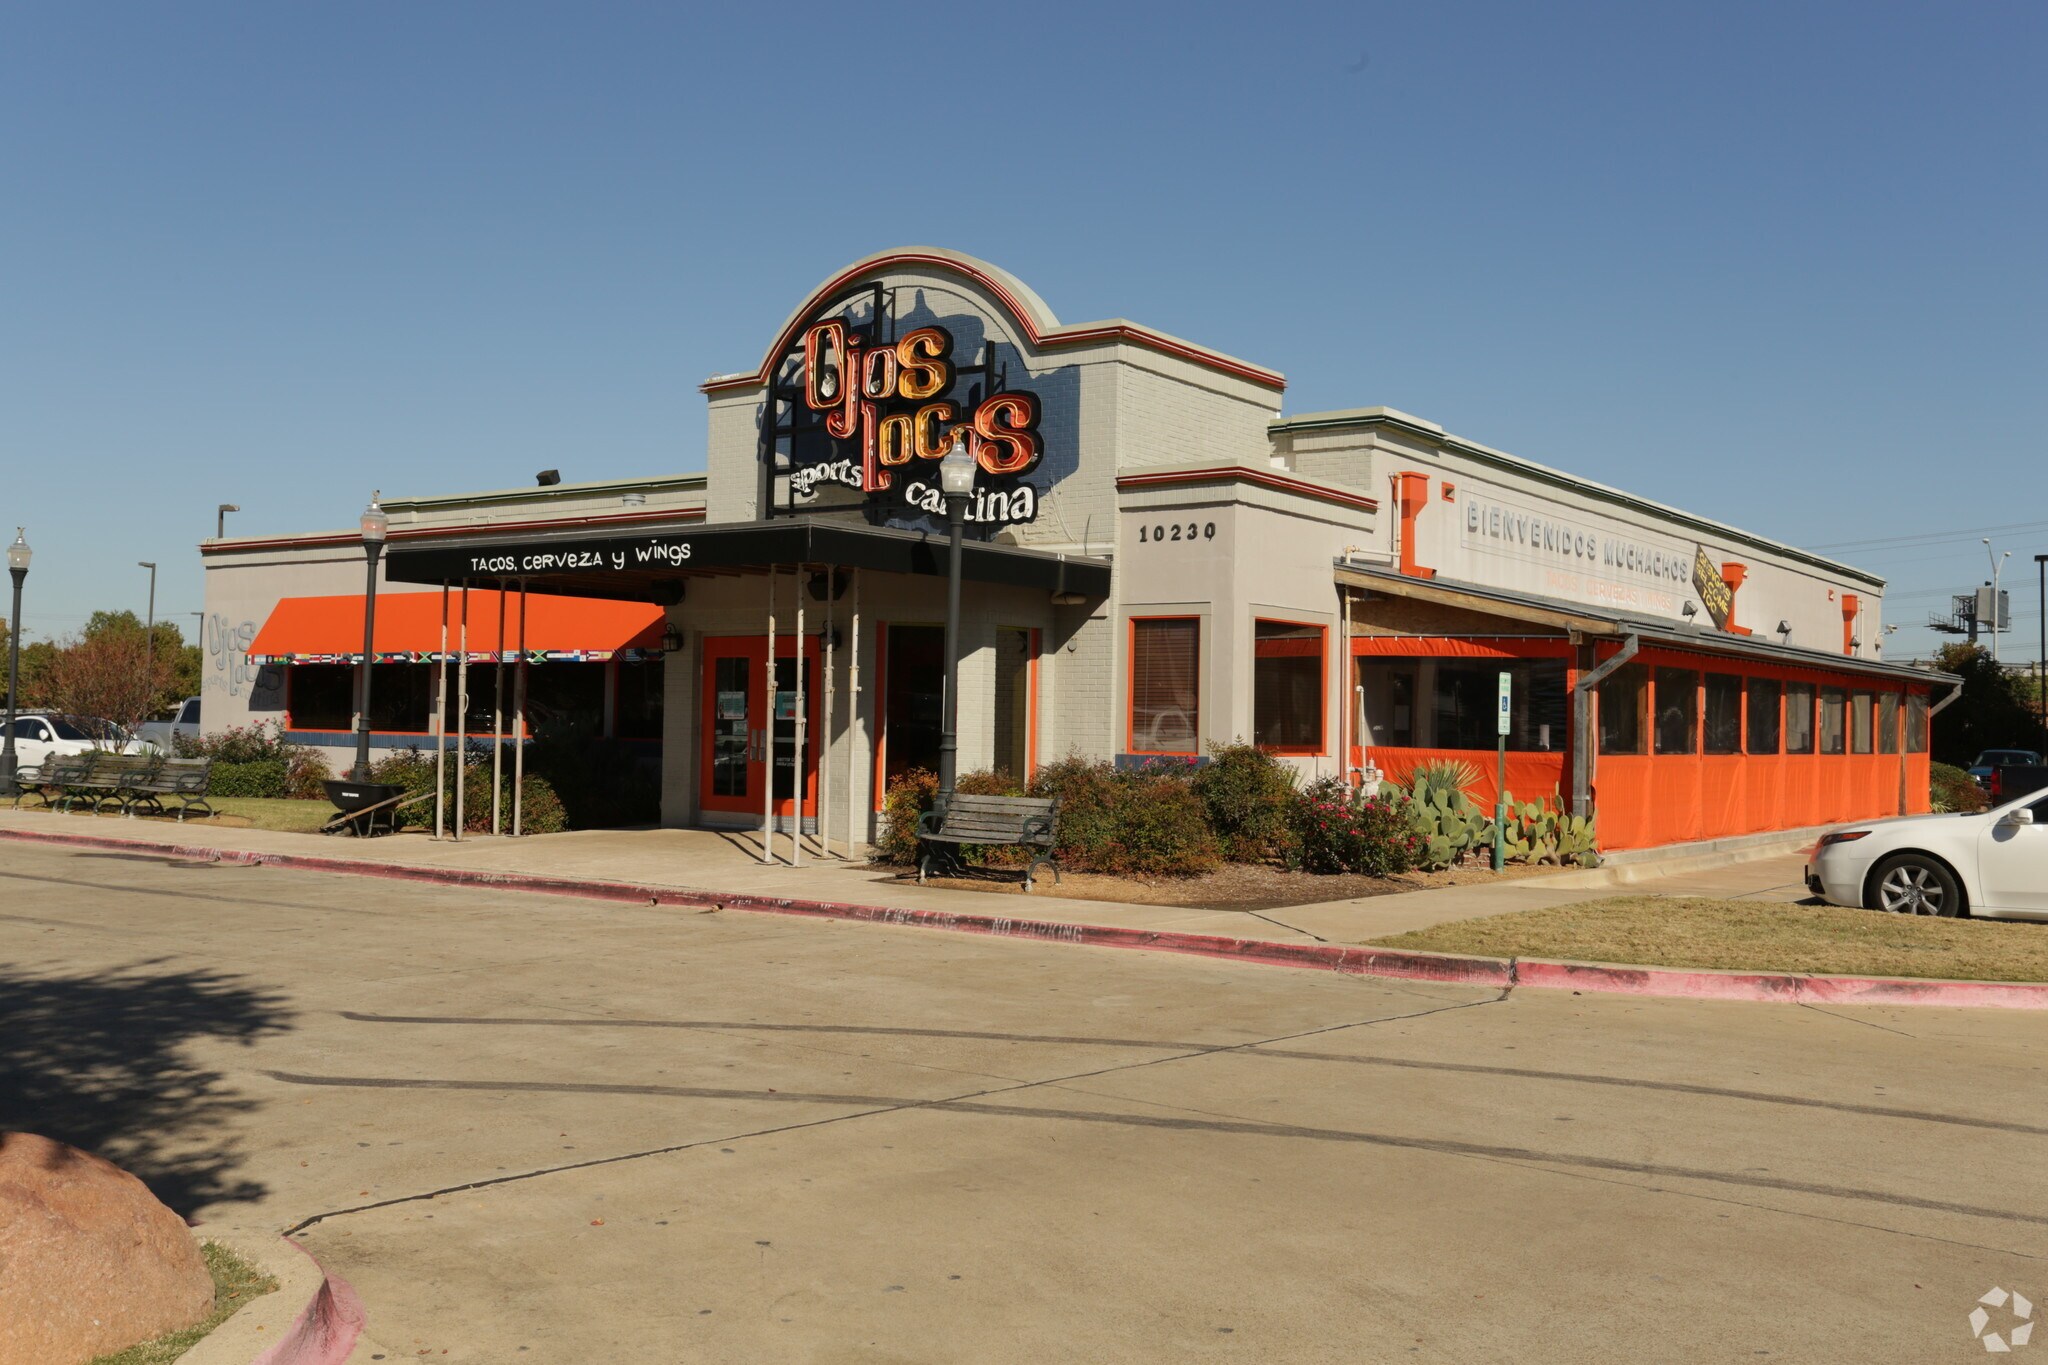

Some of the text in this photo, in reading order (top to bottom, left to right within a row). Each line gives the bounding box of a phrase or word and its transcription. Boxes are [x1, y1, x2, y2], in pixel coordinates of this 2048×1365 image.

[804, 317, 949, 439] Ojos
[790, 458, 863, 493] sports
[905, 481, 1034, 522] caina
[1139, 521, 1216, 542] 10230
[1467, 500, 1688, 583] BIENVENIDOS MUCHACHOS
[1702, 586, 1717, 614] TOO
[991, 917, 1012, 936] NO
[1018, 920, 1083, 943] PARKING
